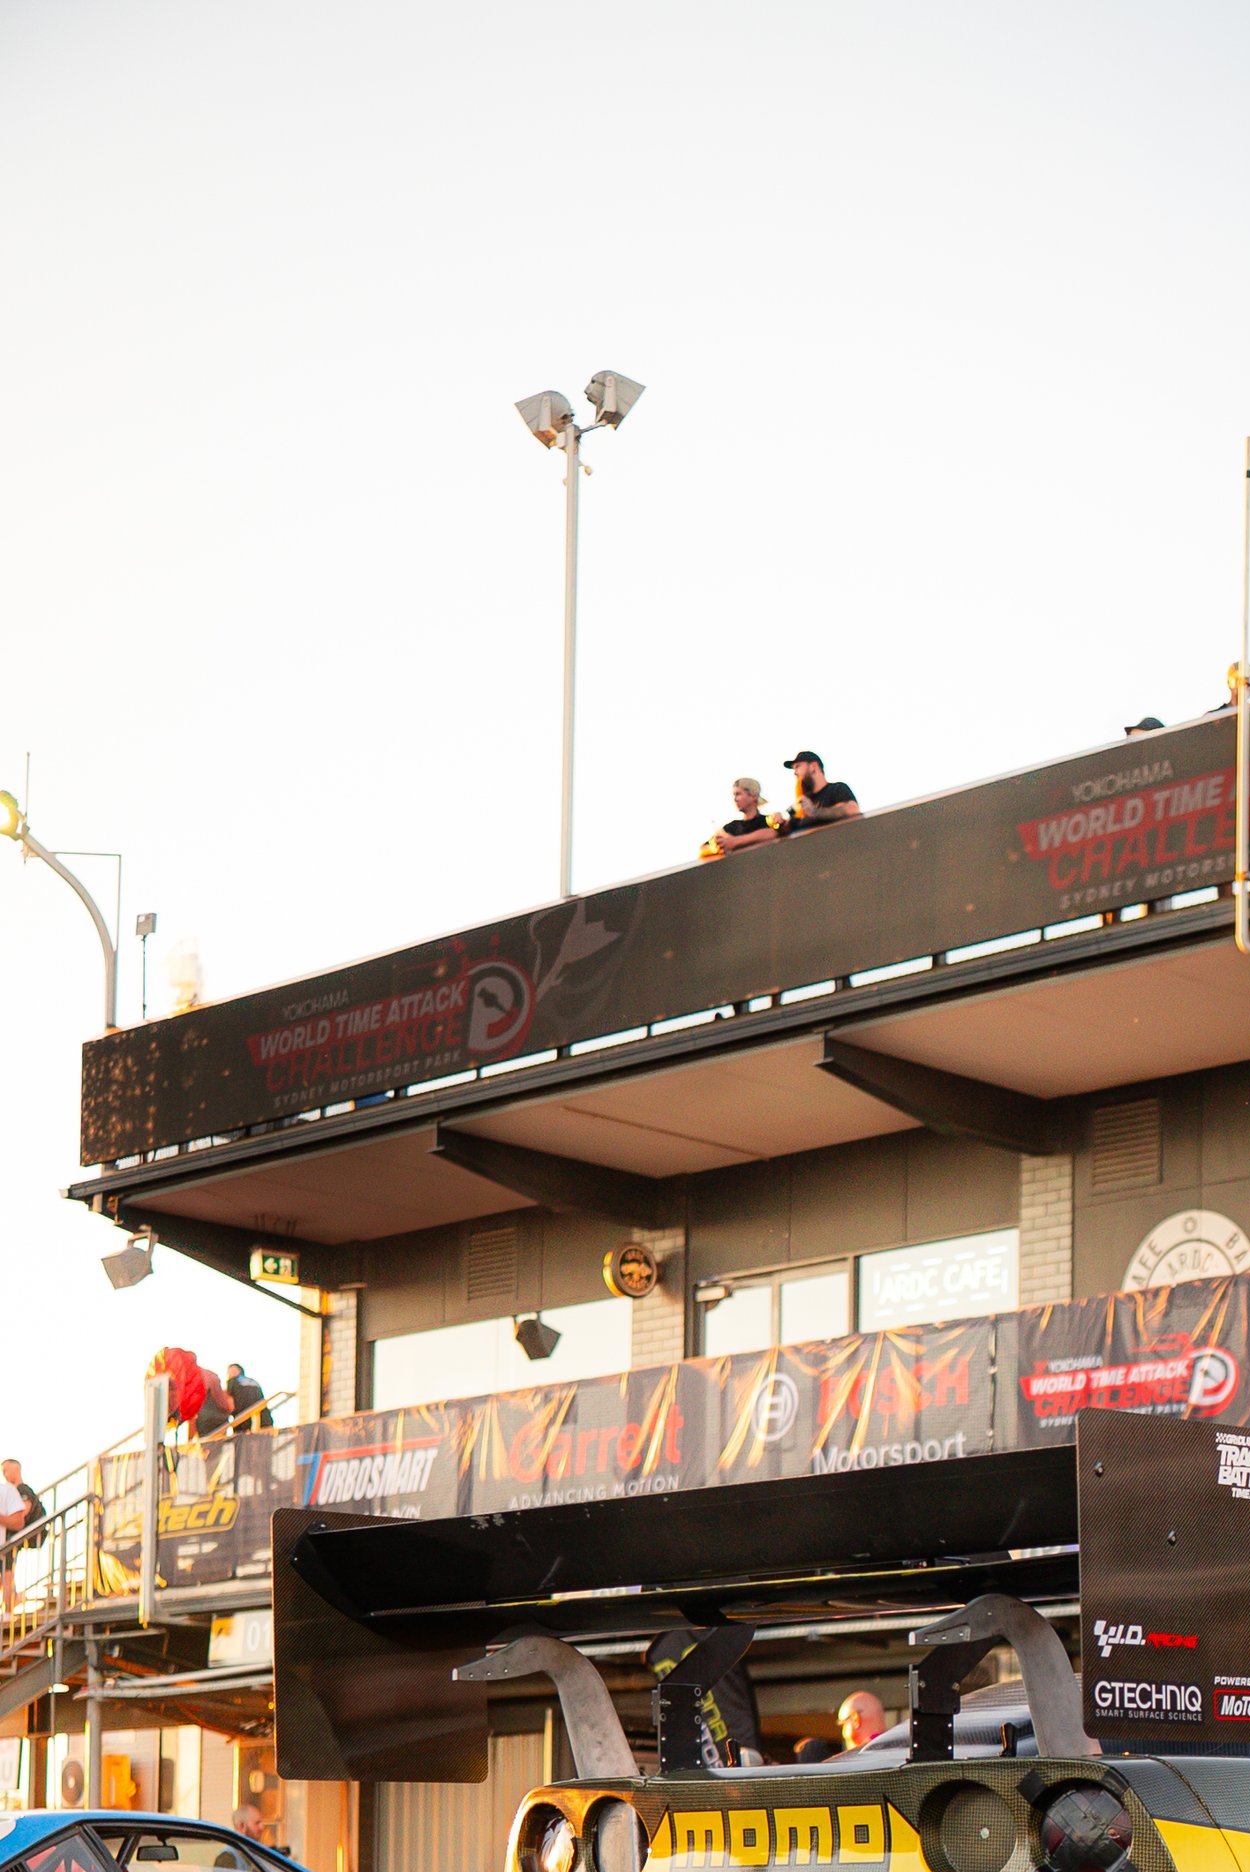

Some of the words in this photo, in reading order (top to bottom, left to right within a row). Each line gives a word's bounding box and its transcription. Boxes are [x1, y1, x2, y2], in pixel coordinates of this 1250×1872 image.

[1073, 759, 1174, 802] YOKOHAMA
[1037, 799, 1144, 851] WORLD
[1153, 775, 1225, 821] TIME
[260, 1020, 330, 1059] WORLD
[336, 1003, 384, 1039] TIME
[386, 981, 465, 1025] ATTACK
[282, 989, 349, 1020] YOKOHAMA
[266, 1014, 463, 1091] CHALLENGE
[876, 1271, 937, 1307] ARDC
[944, 1258, 1004, 1293] CAFE
[1030, 1373, 1087, 1395] WORLD
[1090, 1367, 1125, 1389] TIME
[1128, 1360, 1191, 1385] ATTACK
[296, 1436, 442, 1506] TURBOSMART
[813, 1430, 967, 1474] Motorsport
[509, 1486, 608, 1511] ADVANCING
[613, 1475, 680, 1496] MOTION
[245, 1620, 272, 1653] 01
[1094, 1681, 1203, 1713] GTECHNIQ
[1095, 1708, 1125, 1718] SMART
[1128, 1710, 1165, 1720] SURFACE
[1167, 1712, 1203, 1722] SCIENCE
